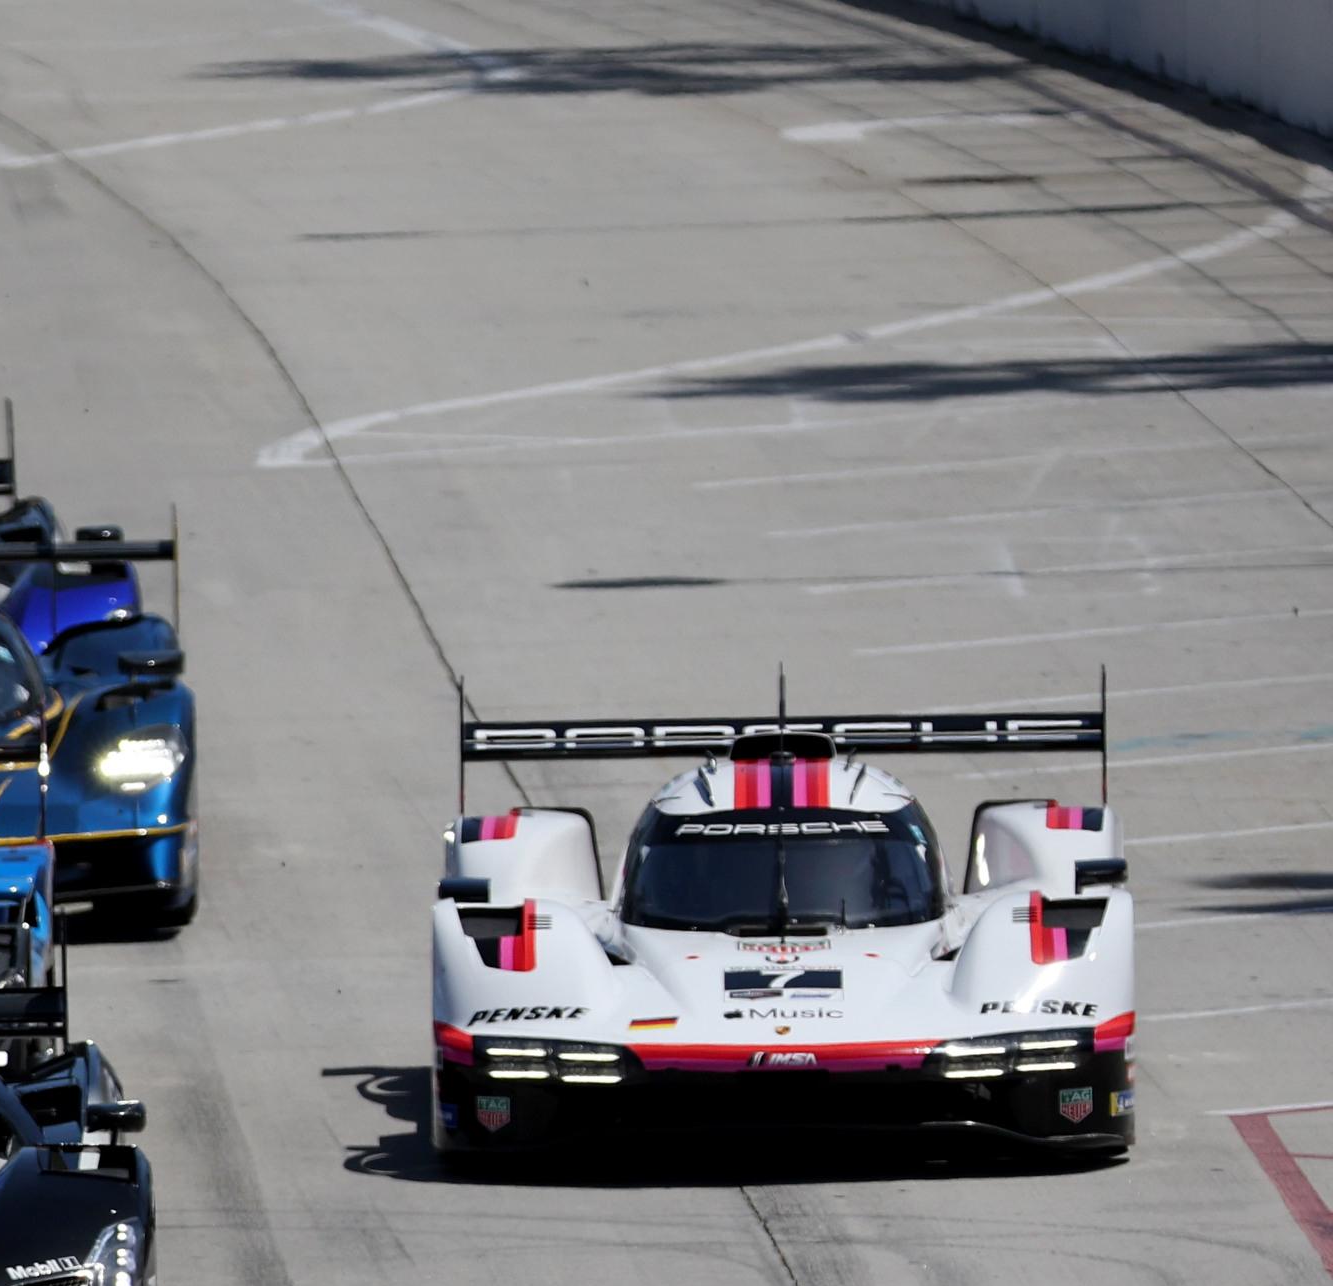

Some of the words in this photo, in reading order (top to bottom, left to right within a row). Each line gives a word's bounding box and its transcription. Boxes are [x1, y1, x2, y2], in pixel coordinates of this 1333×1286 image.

[675, 821, 889, 837] PORSCHE
[761, 969, 806, 989] 7
[467, 1006, 591, 1027] PENSKE
[749, 1007, 844, 1019] Music
[769, 1052, 817, 1066] IMSA
[481, 1098, 508, 1110] TAG
[1066, 1091, 1090, 1102] TAG
[5, 1258, 62, 1280] Mobil
